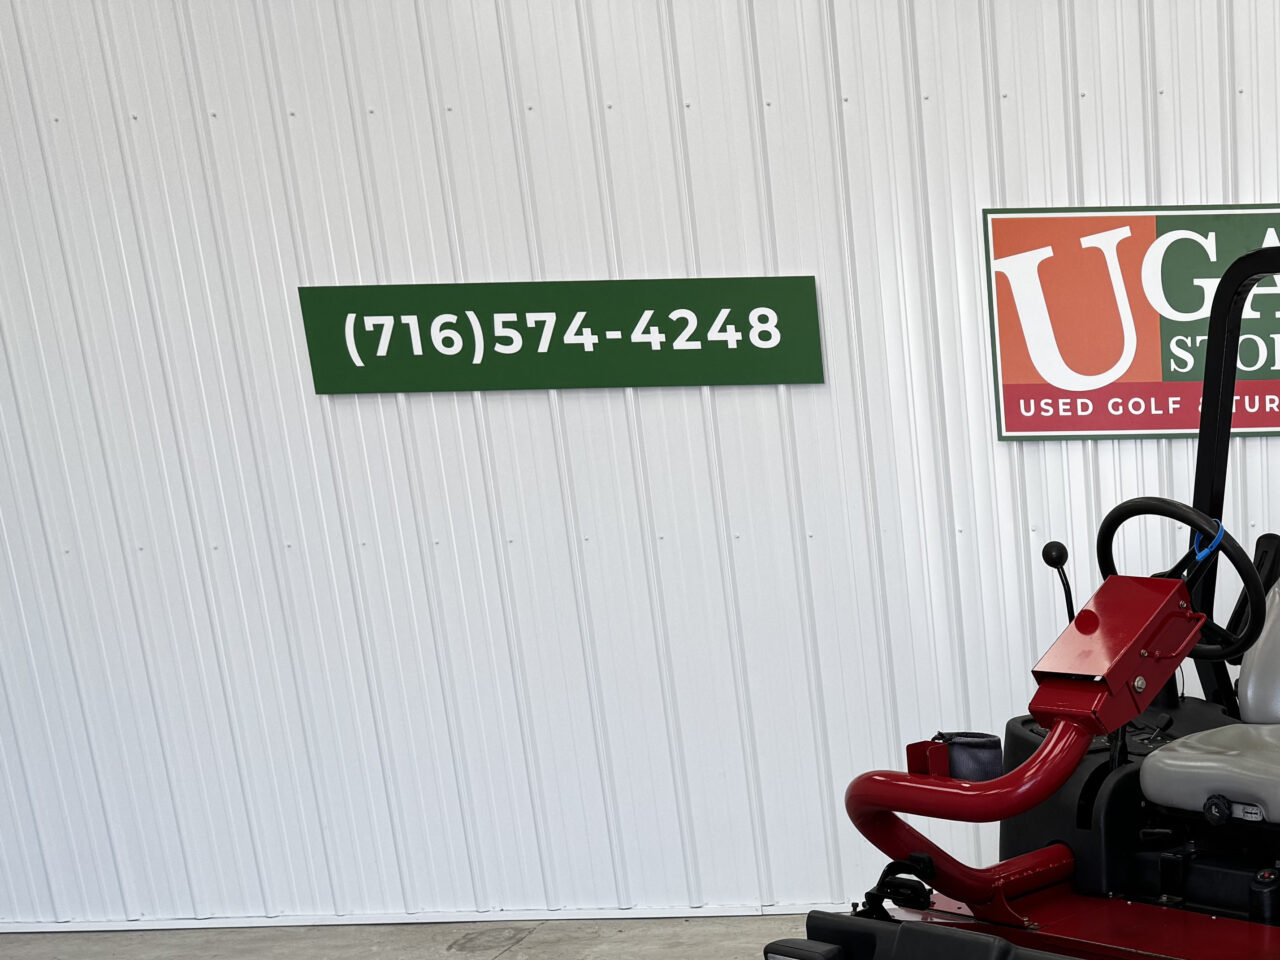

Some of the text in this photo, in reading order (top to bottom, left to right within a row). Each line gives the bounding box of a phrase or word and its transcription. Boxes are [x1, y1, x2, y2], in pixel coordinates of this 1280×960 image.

[345, 307, 782, 367] (716)574-4248
[1019, 398, 1094, 417] USED
[1107, 396, 1181, 416] GOLF
